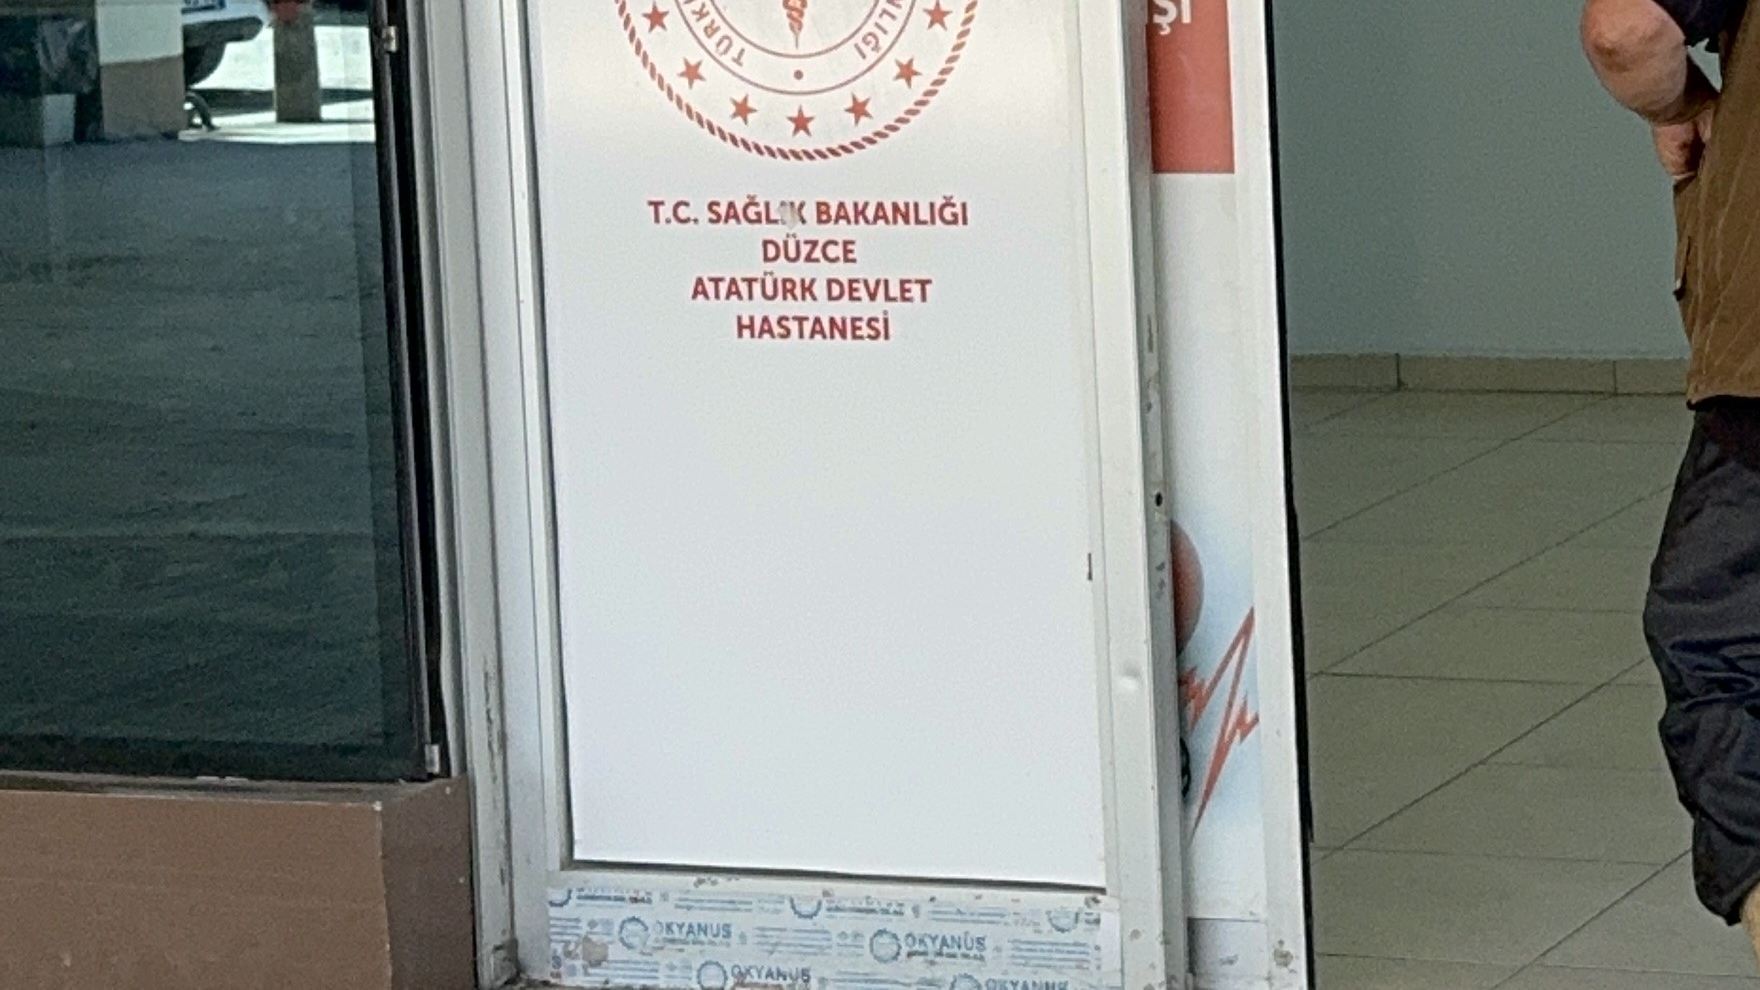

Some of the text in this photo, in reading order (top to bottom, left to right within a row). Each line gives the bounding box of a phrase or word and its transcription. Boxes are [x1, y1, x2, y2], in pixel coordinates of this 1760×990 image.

[647, 200, 699, 226] T.C.
[815, 195, 969, 226] BAKANLIĞI
[762, 232, 857, 264] DÜZCE
[691, 271, 933, 303] ATATÜRK DEVLET
[736, 309, 890, 341] HASTANESİ
